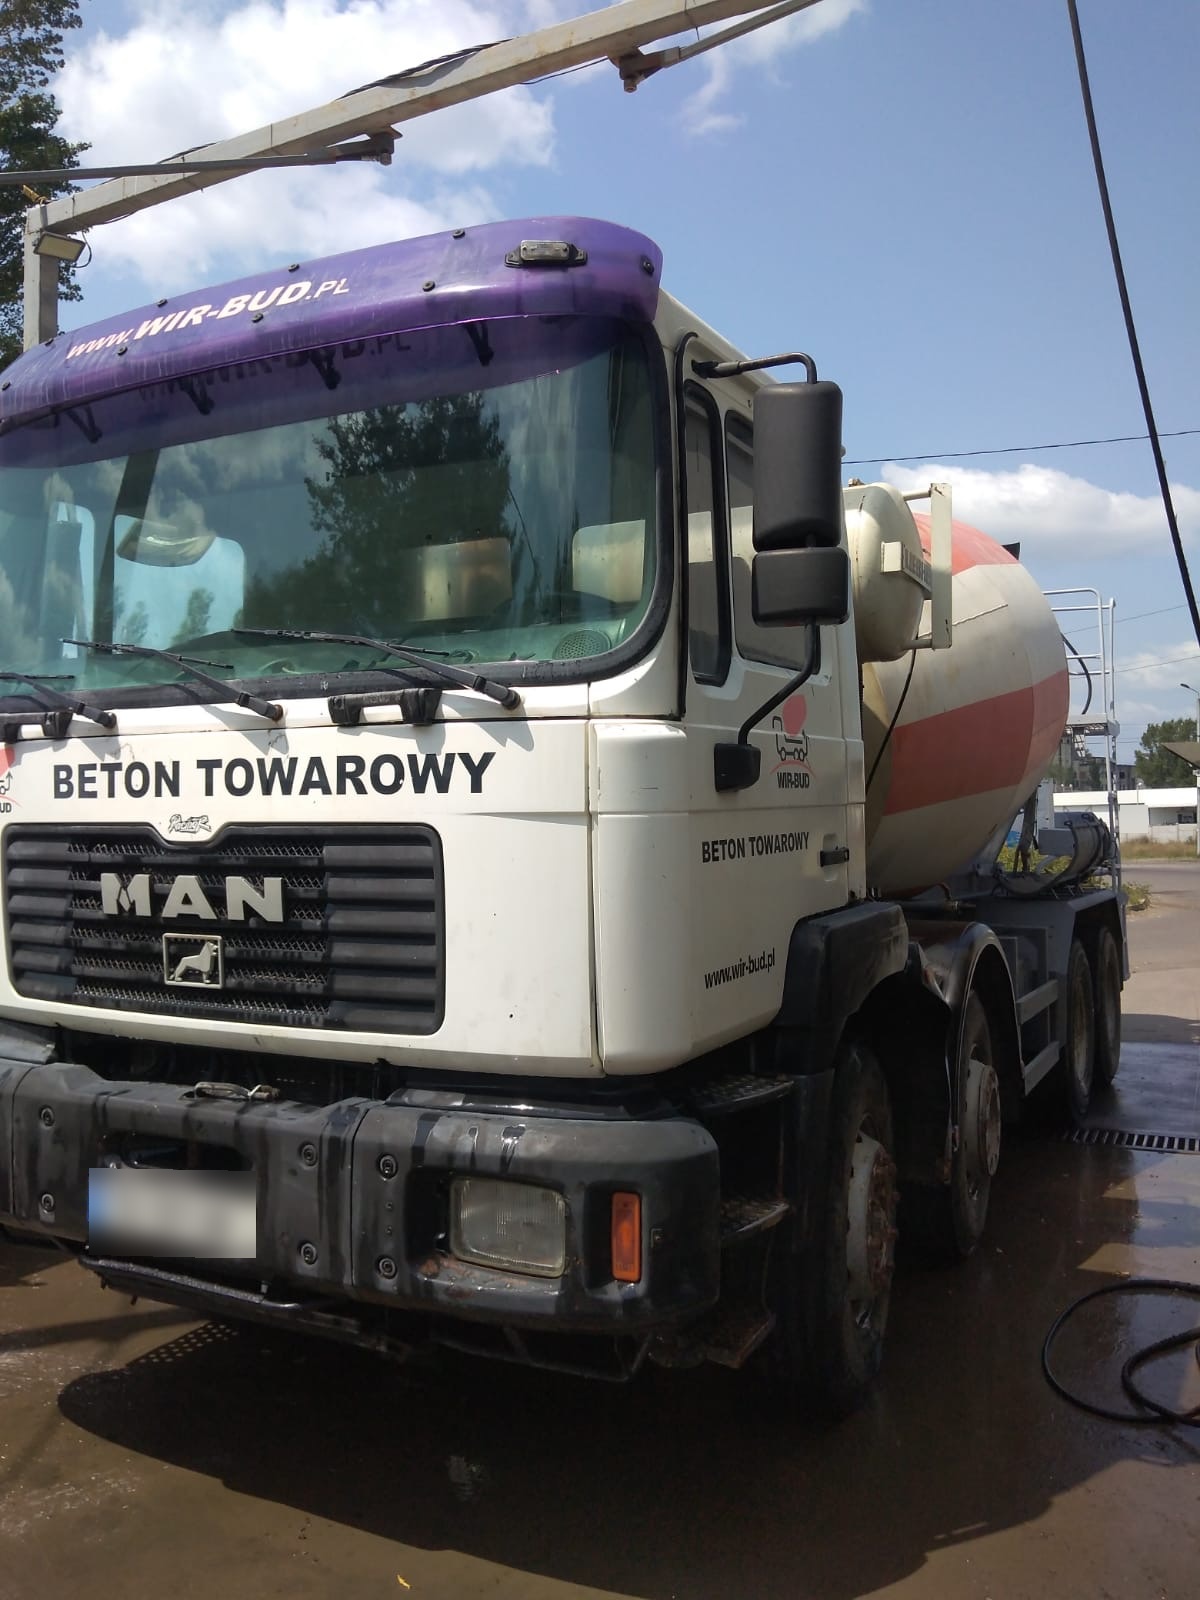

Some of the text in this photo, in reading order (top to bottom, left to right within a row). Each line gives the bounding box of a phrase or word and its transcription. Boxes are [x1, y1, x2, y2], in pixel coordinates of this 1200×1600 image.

[54, 752, 496, 799] BETON TOWAROWY
[777, 772, 810, 789] WIR-BUD
[702, 832, 810, 863] BETON TOWAROWY
[100, 872, 284, 923] MAN
[704, 948, 776, 990] www.wir-bud.pl
